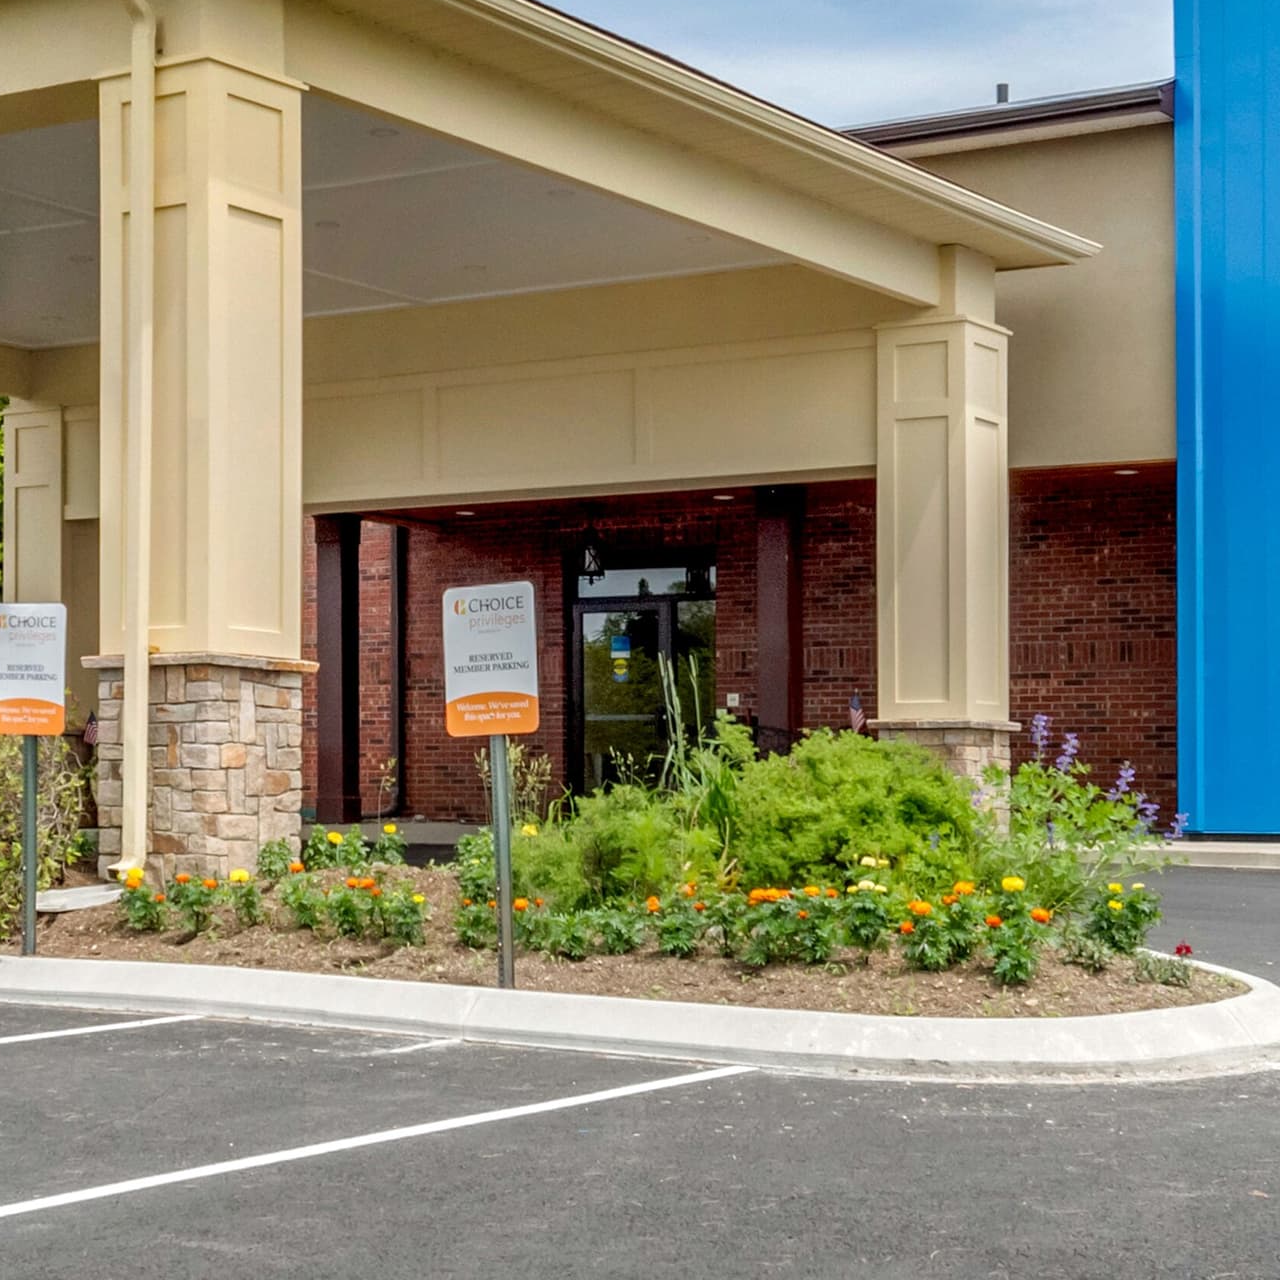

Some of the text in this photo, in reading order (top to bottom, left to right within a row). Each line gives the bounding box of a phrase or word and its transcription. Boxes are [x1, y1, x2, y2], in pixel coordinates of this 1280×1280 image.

[468, 595, 524, 613] CHOICE
[8, 615, 56, 628] CHOICE
[469, 613, 526, 632] privileges
[468, 652, 513, 663] RESERVED
[453, 662, 529, 674] MEMBER PARKING
